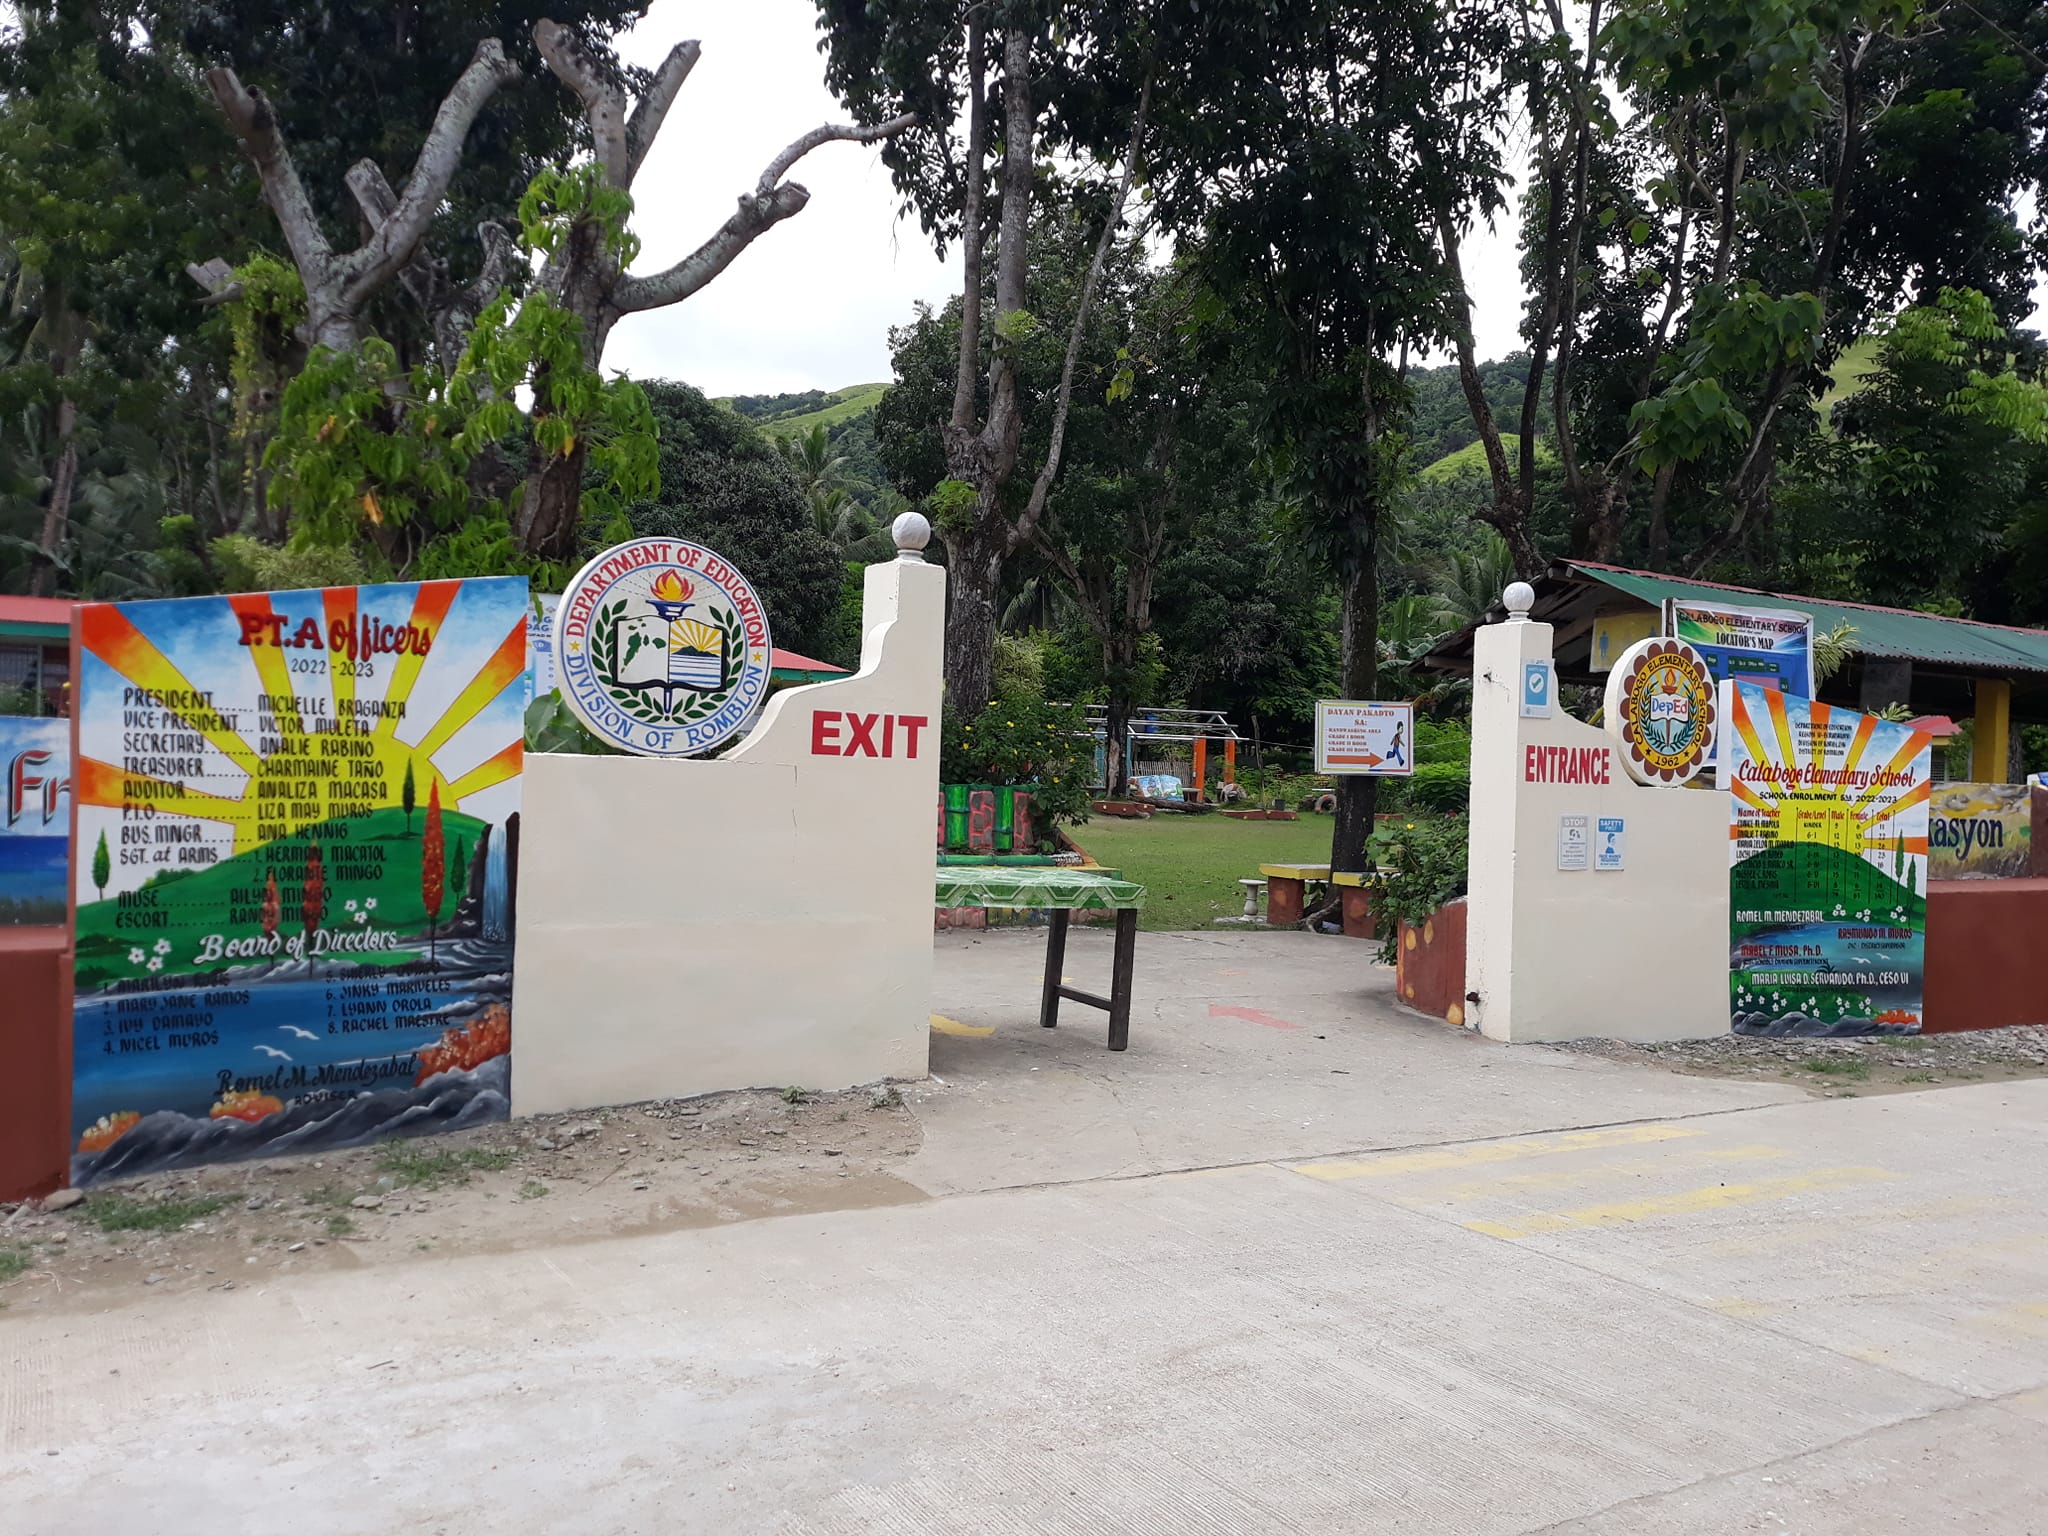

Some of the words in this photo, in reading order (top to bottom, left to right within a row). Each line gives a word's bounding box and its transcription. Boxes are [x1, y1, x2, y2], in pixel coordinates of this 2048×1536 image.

[566, 543, 671, 639] DEPARTMENT
[676, 546, 702, 568] OF
[702, 557, 767, 648] EDUCATION
[1679, 612, 1724, 625] CALABOGO
[1725, 617, 1778, 631] ELEMENTARY
[1778, 623, 1806, 634] SCHOOL
[1716, 632, 1757, 648] LOCATOR'S
[1757, 637, 1775, 650] MAP
[123, 687, 213, 708] PRESIDENT
[258, 694, 326, 715] MICHELLE
[338, 699, 406, 719] BRAGANZA
[566, 653, 636, 739] DIVISION
[645, 731, 674, 749] OF
[687, 665, 763, 748] ROMBLON
[1629, 671, 1648, 746] CALABOGO
[1648, 655, 1703, 690] ELEMENTARY
[1691, 698, 1706, 749] SCHOOL
[1651, 697, 1689, 717] DepEd
[123, 710, 239, 733] VICE-PRESIDENT
[258, 716, 305, 735] VICTOR
[315, 719, 370, 738] MULETA
[811, 709, 929, 759] EXIT
[123, 733, 204, 754] SECRETARY
[260, 737, 311, 756] ANALIE
[321, 739, 375, 758] RABINO
[123, 757, 204, 778] TREASURER
[257, 759, 339, 778] CHARMAINE
[347, 760, 384, 778] TAÑO
[1525, 744, 1610, 785] ENTRANCE
[1655, 755, 1680, 768] 1962
[1738, 759, 1803, 790] Calabogo
[1803, 762, 1870, 790] Elementary
[1869, 764, 1915, 788] School
[123, 780, 187, 799] AUDITOR
[258, 781, 318, 799] ANALIZA
[328, 781, 388, 799] MACASA
[1759, 792, 1787, 801] SCHOOL
[1788, 793, 1837, 801] ENROLMENT
[1856, 794, 1898, 804] 2022-2023
[258, 802, 286, 820] LIZA
[291, 802, 321, 819] MAY
[328, 802, 374, 819] MUROS
[1737, 808, 1754, 816] Name
[1760, 808, 1781, 818] Teacher
[1831, 811, 1845, 820] Male
[1564, 818, 1585, 827] STOP
[154, 824, 202, 844] MNGR
[258, 824, 288, 841] ANA
[295, 823, 349, 840] HENNIG
[152, 846, 171, 862] at
[178, 847, 218, 863] ARMS
[266, 846, 323, 862] HERMAN
[331, 845, 387, 861] MACATOL
[336, 864, 384, 882] MINGO
[118, 890, 159, 908] MUSE
[116, 911, 168, 929] ESCORT
[1736, 910, 1763, 922] ROMEL
[1764, 911, 1773, 922] M.
[1774, 911, 1824, 923] MENDEZABAL
[193, 930, 283, 965] Board
[285, 928, 307, 961] of
[308, 925, 398, 956] Directors
[1741, 945, 1768, 957] MABEL
[1752, 973, 1778, 985] MARIA
[1780, 973, 1802, 984] LUISA
[1803, 973, 1811, 984] D.
[1879, 972, 1899, 984] CESO
[340, 982, 380, 999] JINKY
[386, 979, 451, 995] MARIVELES
[117, 999, 157, 1014] MARY
[160, 994, 197, 1011] JANE
[204, 989, 250, 1006] RAMOS
[341, 999, 388, 1017] LYANN
[392, 997, 432, 1012] OROLA
[118, 1017, 144, 1033] IVY
[342, 1016, 389, 1034] RACHEL
[119, 1034, 160, 1053] NICEL
[168, 1030, 219, 1048] MUROS
[213, 1064, 285, 1097] Romel
[311, 1052, 419, 1088] Mendezabal
